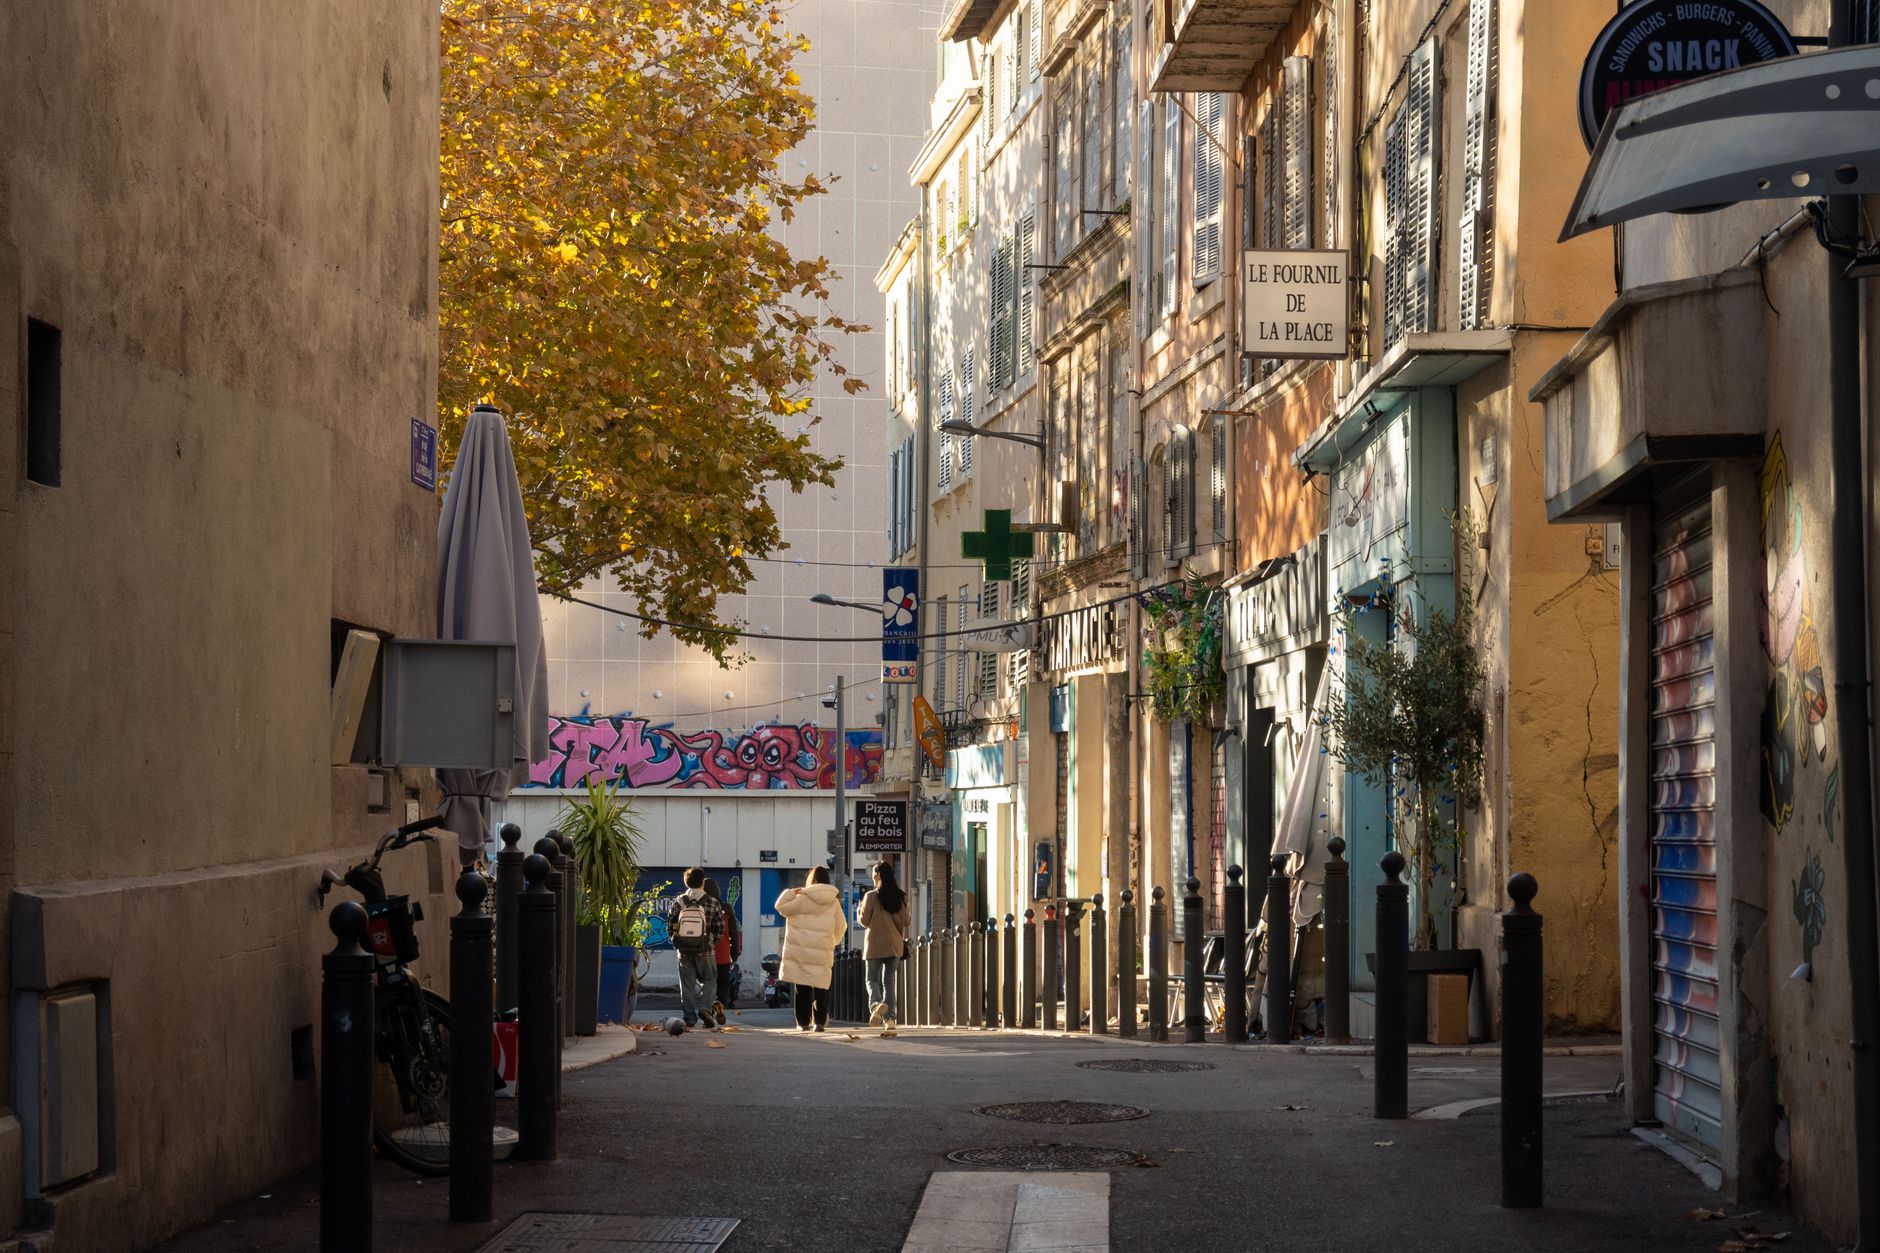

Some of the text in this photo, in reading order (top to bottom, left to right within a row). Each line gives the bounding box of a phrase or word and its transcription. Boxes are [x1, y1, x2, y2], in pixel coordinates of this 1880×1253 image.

[1608, 12, 1667, 73] SANDWICHS
[1675, 4, 1736, 28] BURGERS
[1647, 39, 1742, 73] SNACK
[1248, 263, 1342, 285] LE FOURNIL
[1285, 293, 1306, 313] DE
[1259, 321, 1334, 342] LA PLACE
[966, 629, 998, 642] PMU
[1042, 604, 1114, 672] PHARMACIE
[883, 665, 916, 678] LOTO
[917, 705, 944, 760] TAAC
[865, 803, 897, 814] Pizza
[860, 815, 899, 825] au feu
[859, 826, 903, 837] de bois
[858, 842, 865, 850] À
